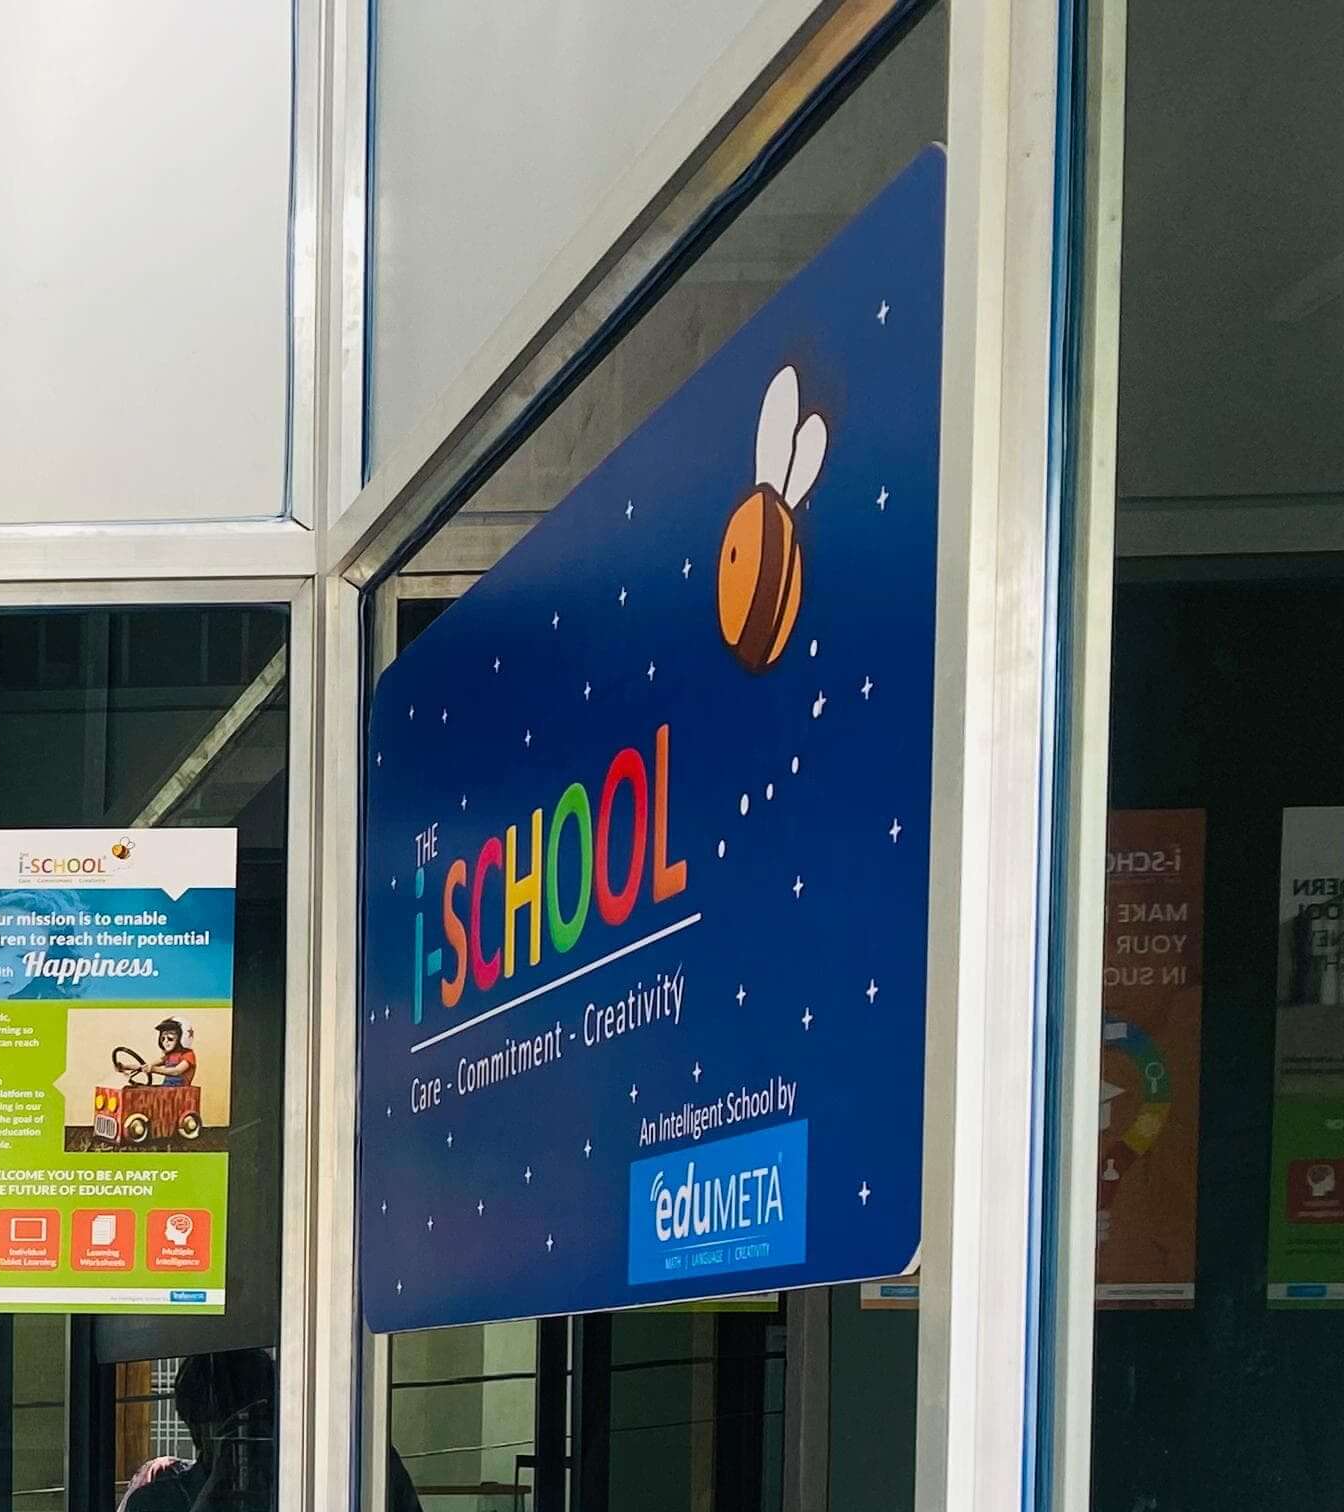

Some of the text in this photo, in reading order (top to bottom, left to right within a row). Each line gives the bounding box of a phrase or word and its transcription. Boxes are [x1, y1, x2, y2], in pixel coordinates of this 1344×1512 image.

[414, 821, 439, 869] THE
[18, 857, 107, 874] i-SCHOOL
[413, 723, 688, 1026] i-SCHOOL
[16, 911, 76, 927] mission
[79, 912, 91, 927] is
[94, 914, 111, 927] to
[114, 911, 168, 927] enable
[30, 935, 47, 947] to
[49, 933, 92, 947] reach
[96, 932, 134, 946] their
[138, 931, 210, 950] potential
[22, 952, 160, 986] Happiness.
[411, 974, 685, 1116] Care Commitment Creativity
[639, 1078, 797, 1149] An Intelligent School by
[8, 1185, 58, 1196] FUTURE
[59, 1185, 77, 1196] OF
[79, 1185, 153, 1196] EDUCATION
[47, 1170, 74, 1181] YOU
[75, 1170, 95, 1181] TO
[96, 1170, 113, 1181] BE
[114, 1170, 123, 1181] A
[125, 1170, 158, 1181] PART
[160, 1170, 178, 1181] OF
[656, 1162, 783, 1242] eduMETA
